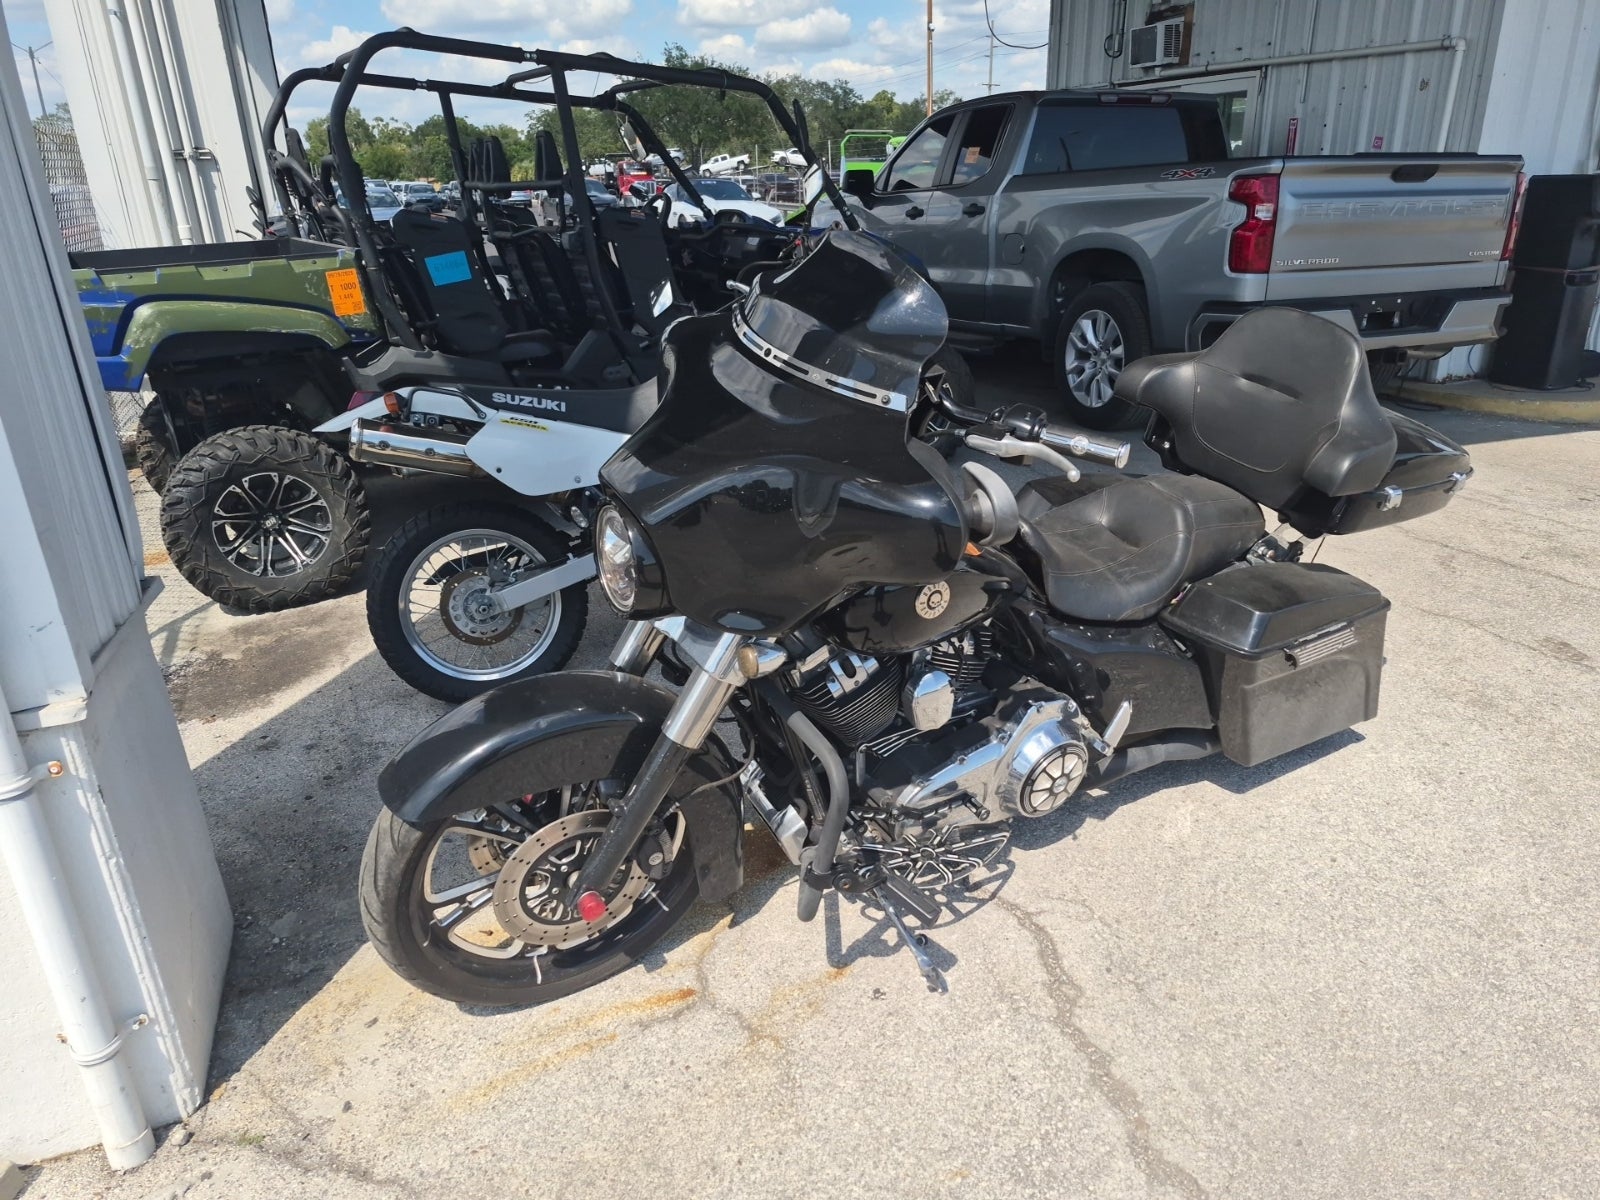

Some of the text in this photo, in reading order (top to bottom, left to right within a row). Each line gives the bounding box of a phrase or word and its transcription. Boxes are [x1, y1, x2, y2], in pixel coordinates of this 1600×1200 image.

[1275, 257, 1340, 267] SILVERADO
[340, 281, 357, 291] 1000
[491, 392, 566, 413] SUZUKI
